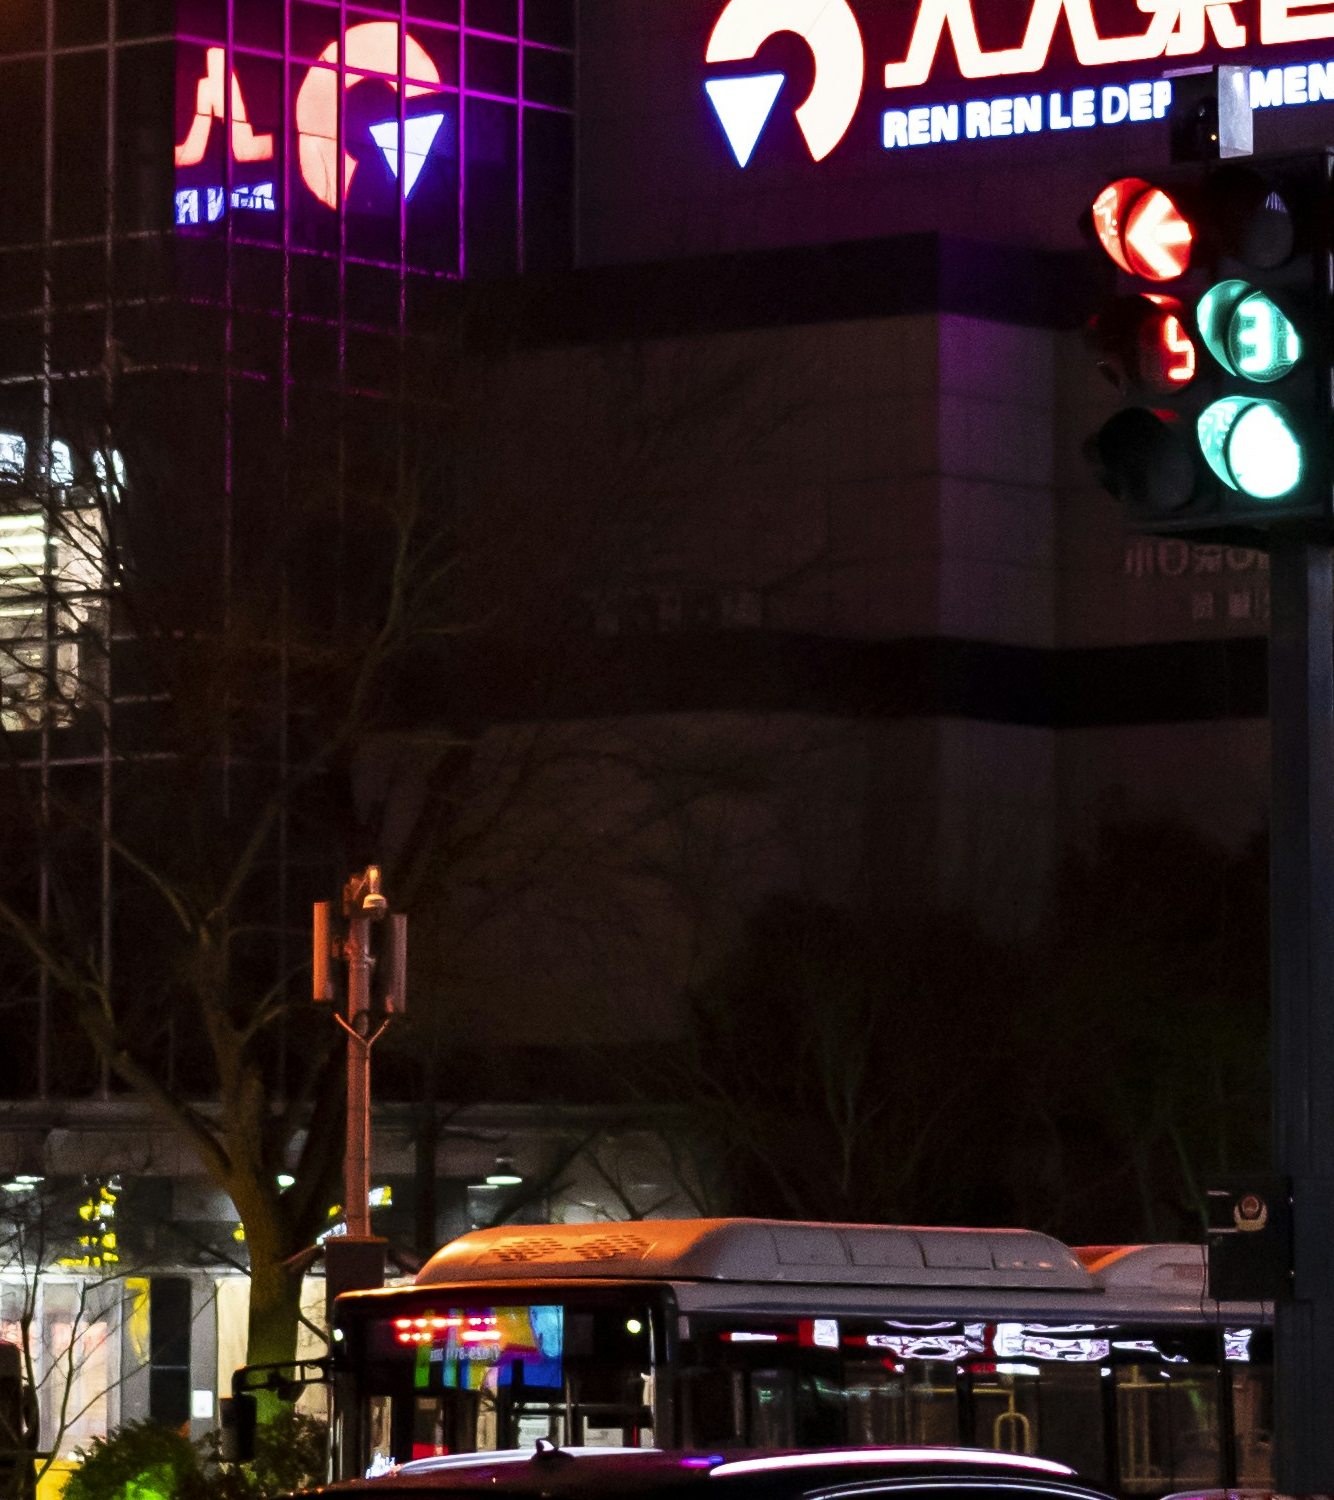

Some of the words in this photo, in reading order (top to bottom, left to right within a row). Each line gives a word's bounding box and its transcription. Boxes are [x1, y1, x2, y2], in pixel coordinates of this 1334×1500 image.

[883, 109, 960, 148] REN
[966, 100, 1042, 140] REN
[1050, 89, 1094, 130] LE
